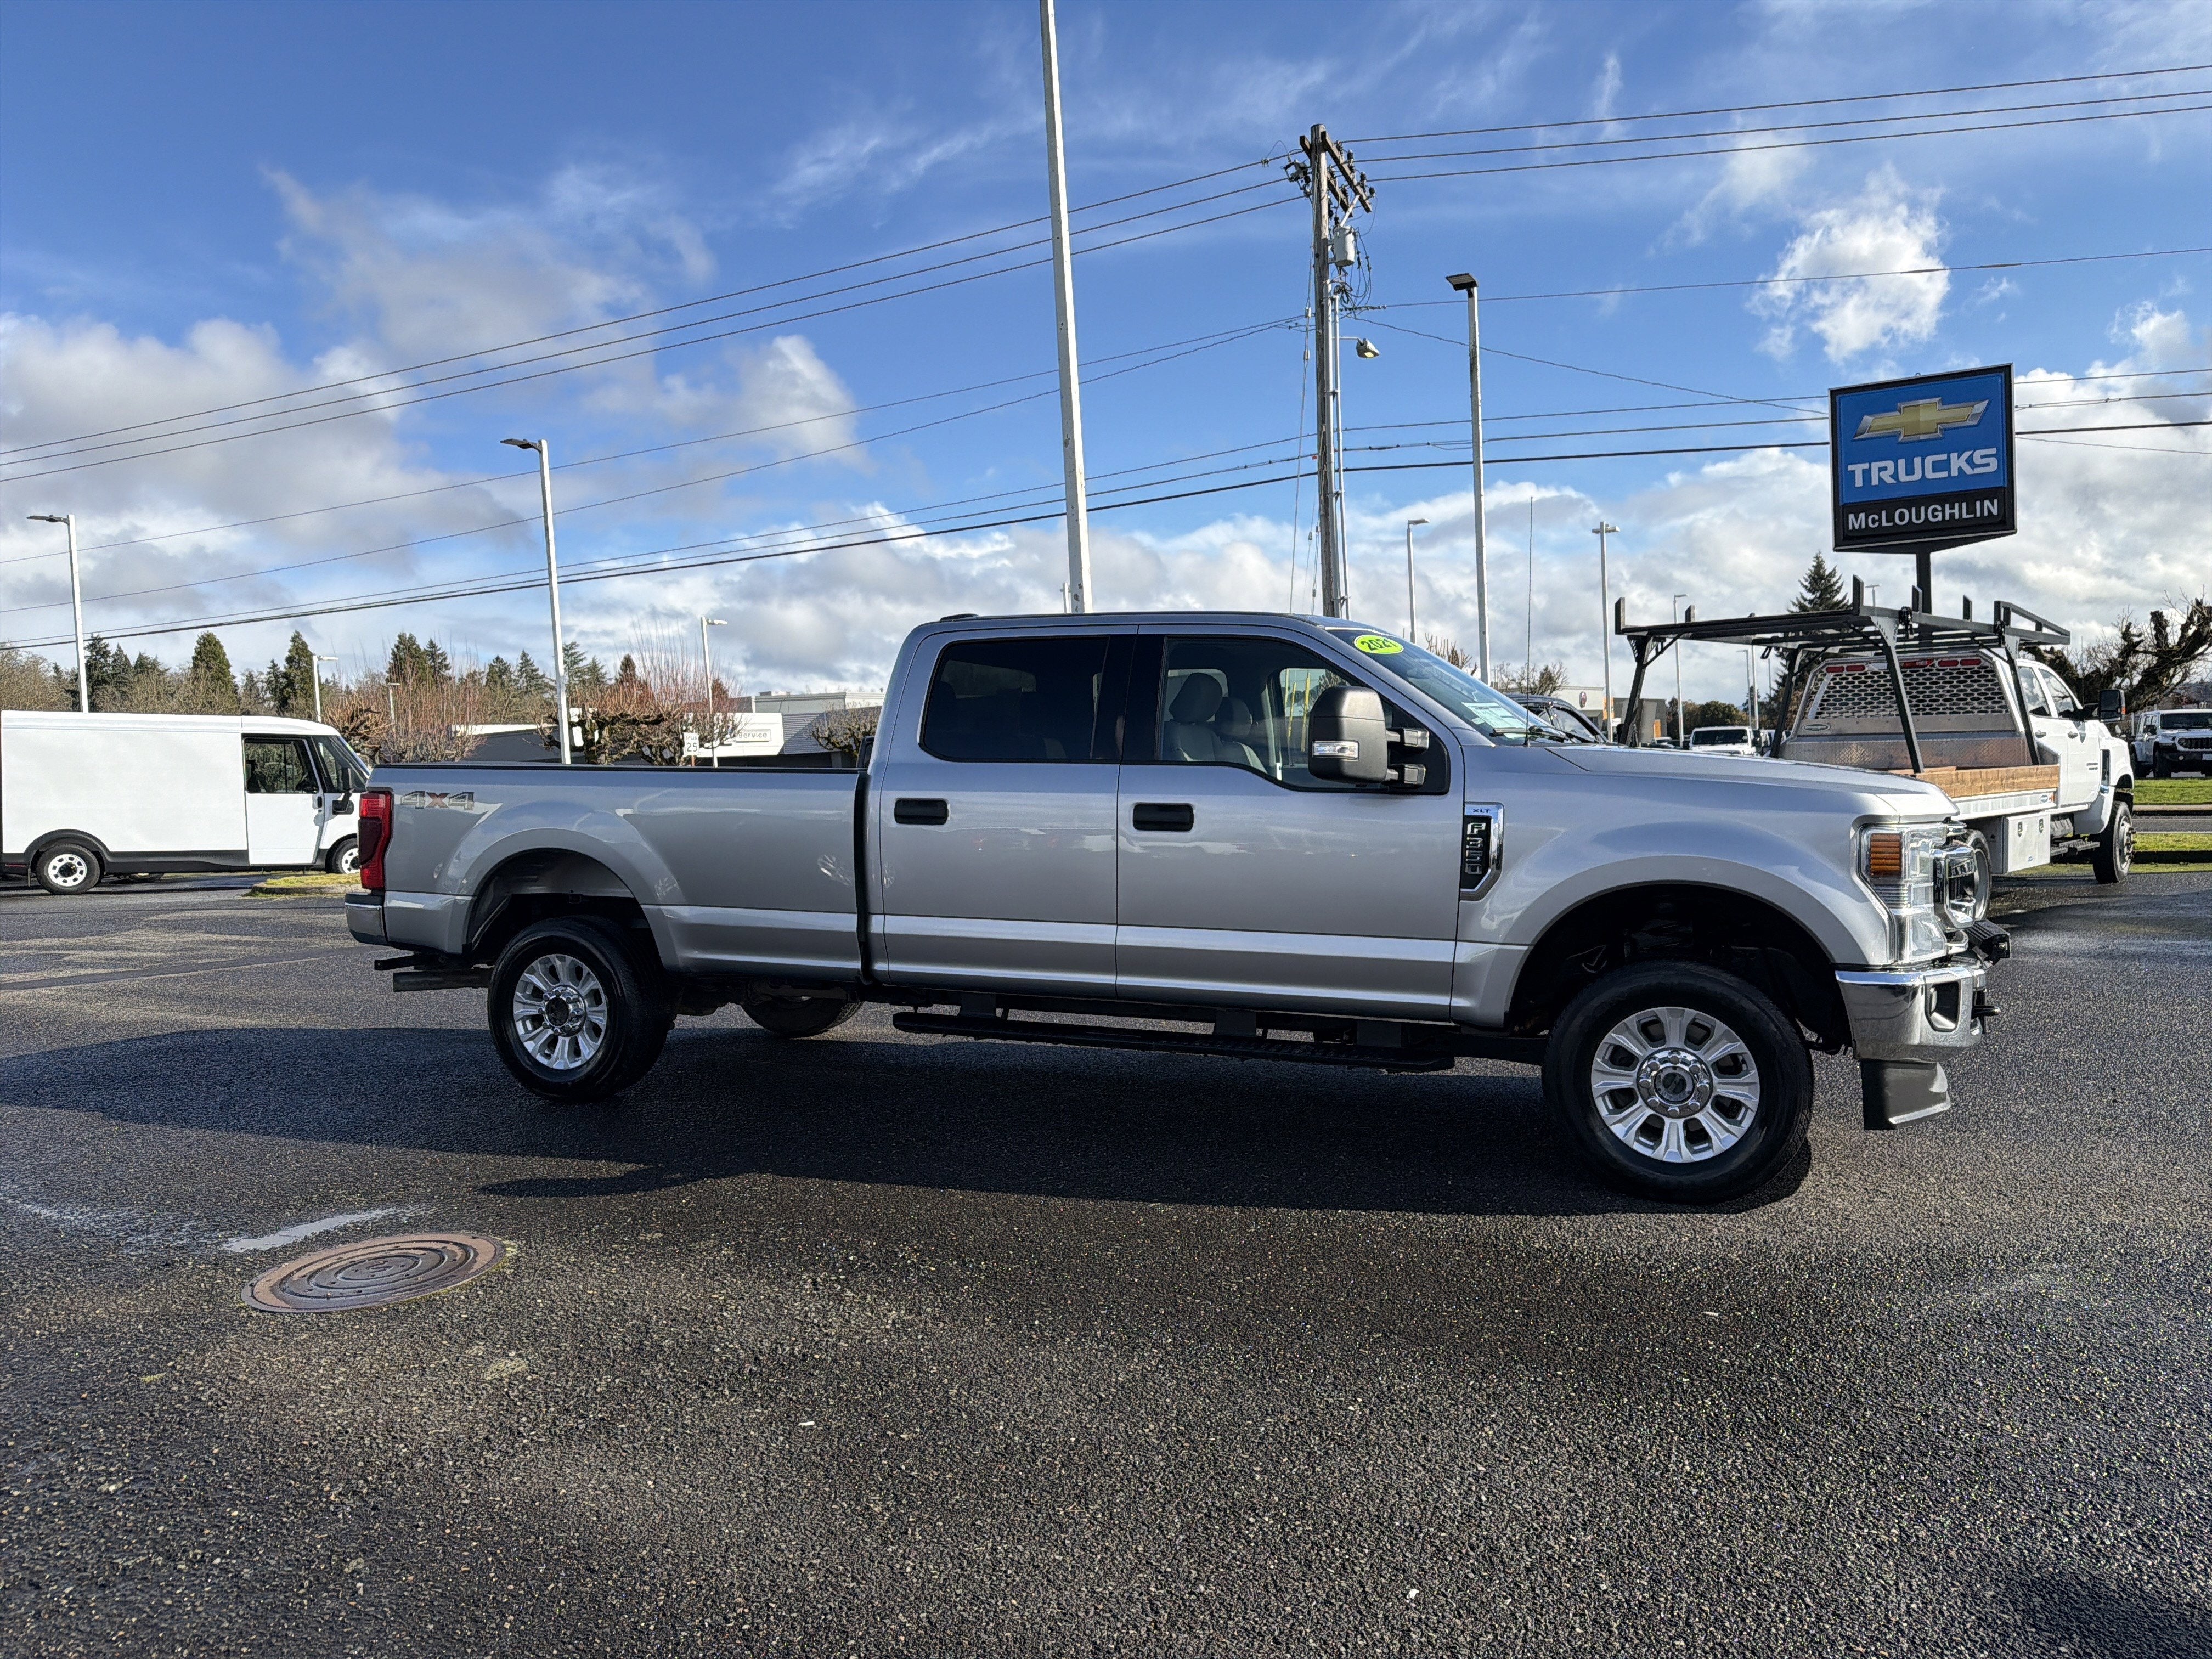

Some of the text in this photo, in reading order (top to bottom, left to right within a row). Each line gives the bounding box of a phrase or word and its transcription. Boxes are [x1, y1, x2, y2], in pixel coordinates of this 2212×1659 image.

[1848, 448, 1998, 488] TRUCKS
[1848, 498, 1998, 531] McLOUGHLIN
[1361, 638, 1398, 651] 2021
[687, 742, 698, 752] 25
